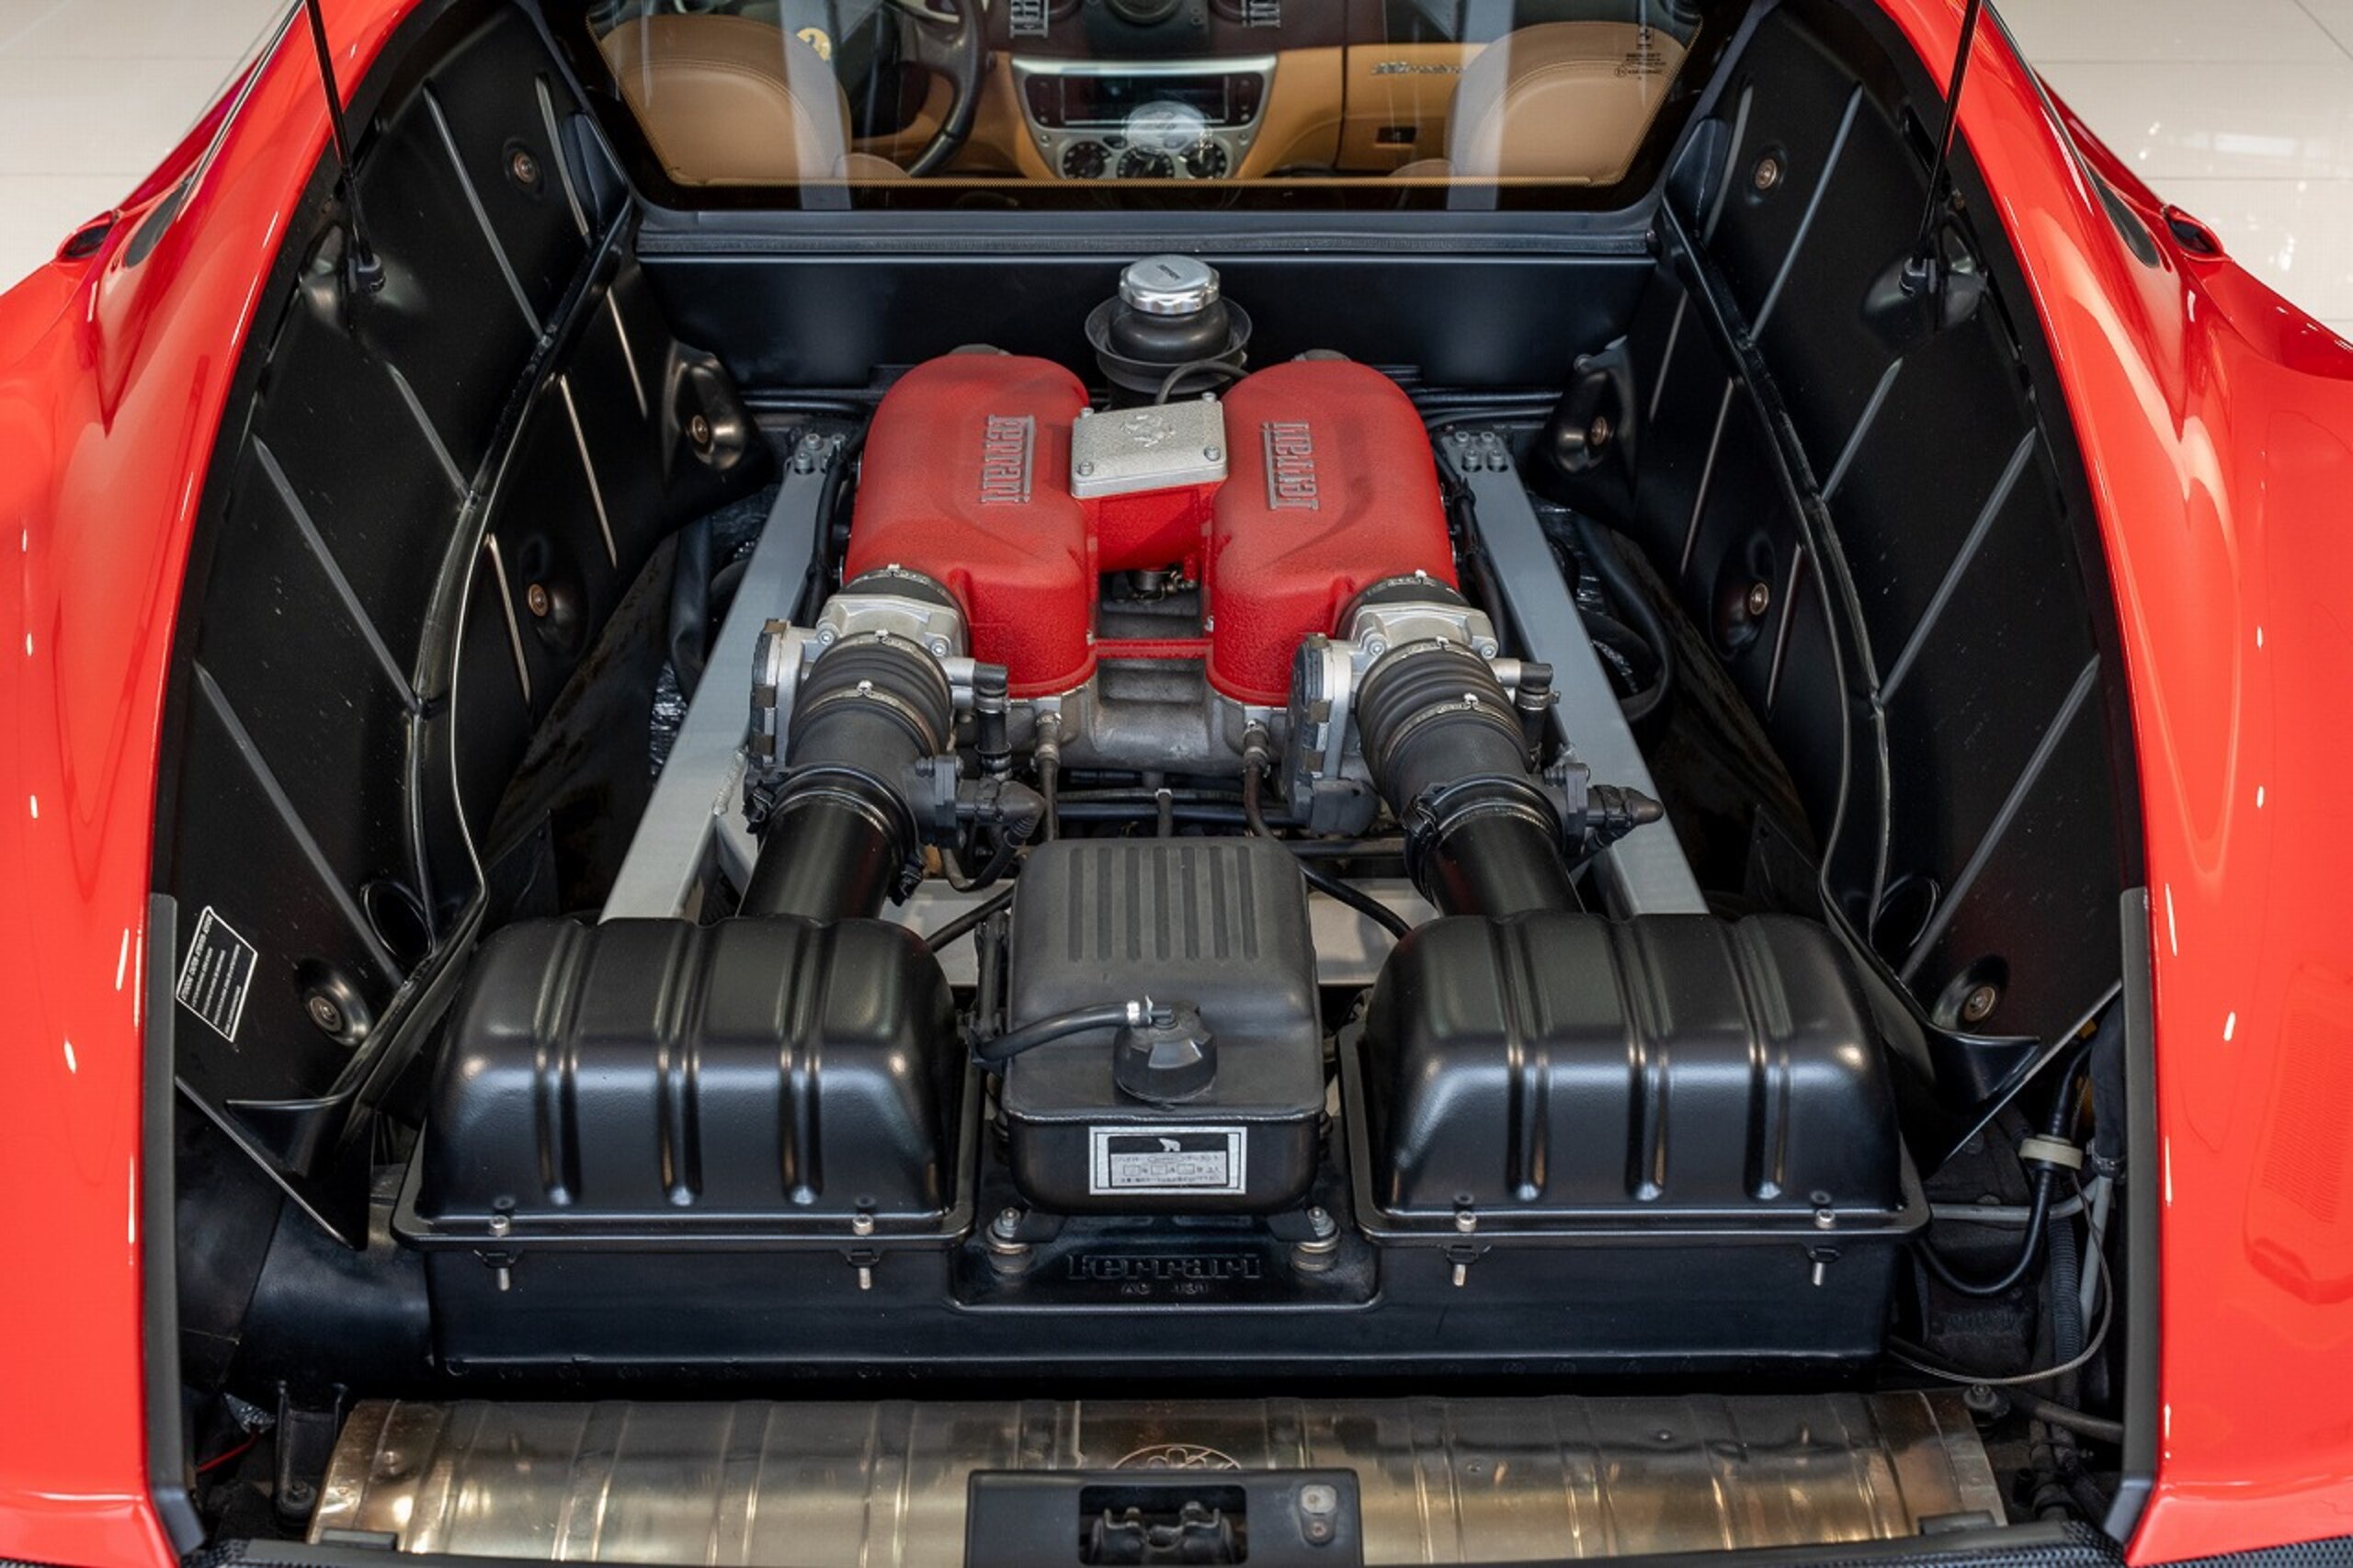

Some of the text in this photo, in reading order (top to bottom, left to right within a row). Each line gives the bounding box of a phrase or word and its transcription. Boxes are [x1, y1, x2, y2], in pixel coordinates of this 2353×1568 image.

[981, 415, 1034, 504] Ferrari
[1260, 420, 1318, 510] Ferrari
[1066, 1253, 1263, 1279] Ferrari
